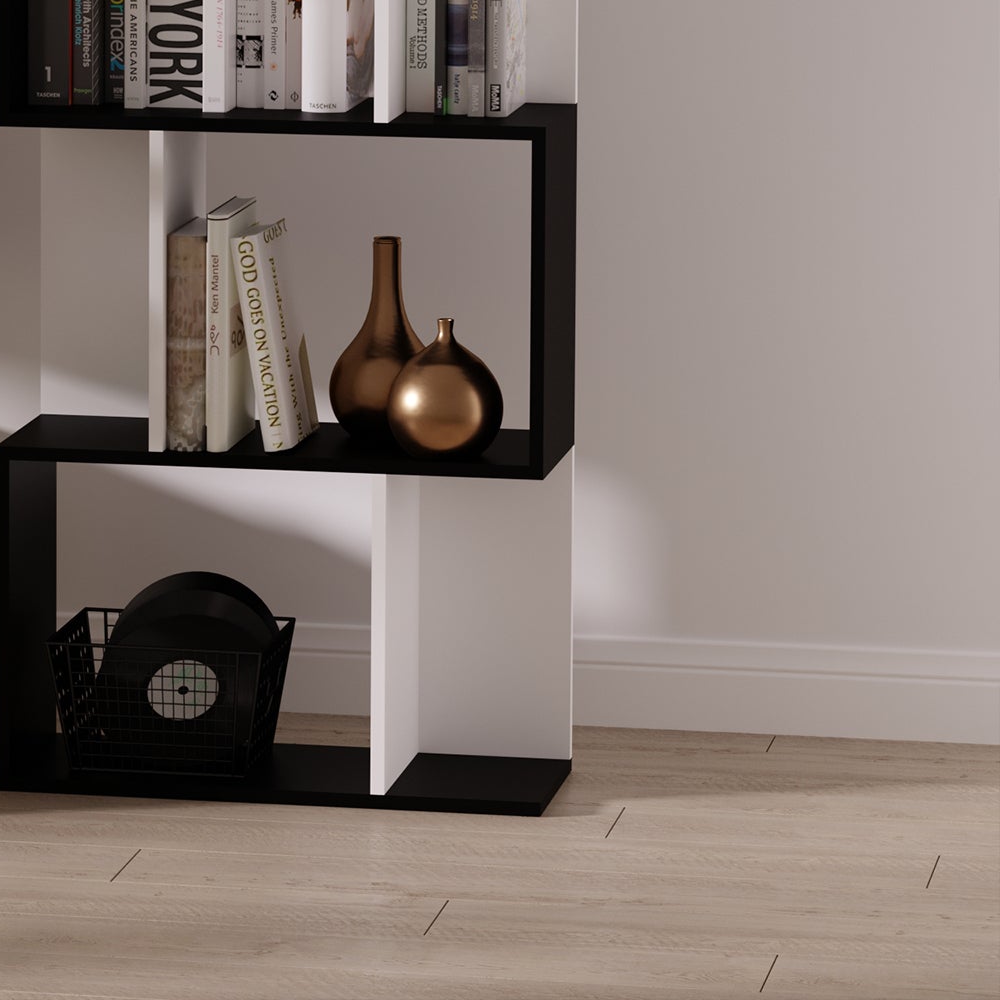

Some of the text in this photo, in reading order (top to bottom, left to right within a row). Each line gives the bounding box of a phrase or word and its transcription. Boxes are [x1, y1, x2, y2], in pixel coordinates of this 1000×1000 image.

[75, 26, 83, 46] Klotz
[82, 16, 92, 68] Architects
[129, 14, 138, 82] AMERICANS
[271, 26, 279, 56] Primer
[417, 8, 428, 69] METHODS
[44, 66, 51, 82] 1
[309, 102, 337, 110] TASCHEN
[490, 85, 500, 111] MoMA
[211, 254, 219, 314] Ken Mantel
[237, 239, 281, 428] GOD GOES ON VACATION
